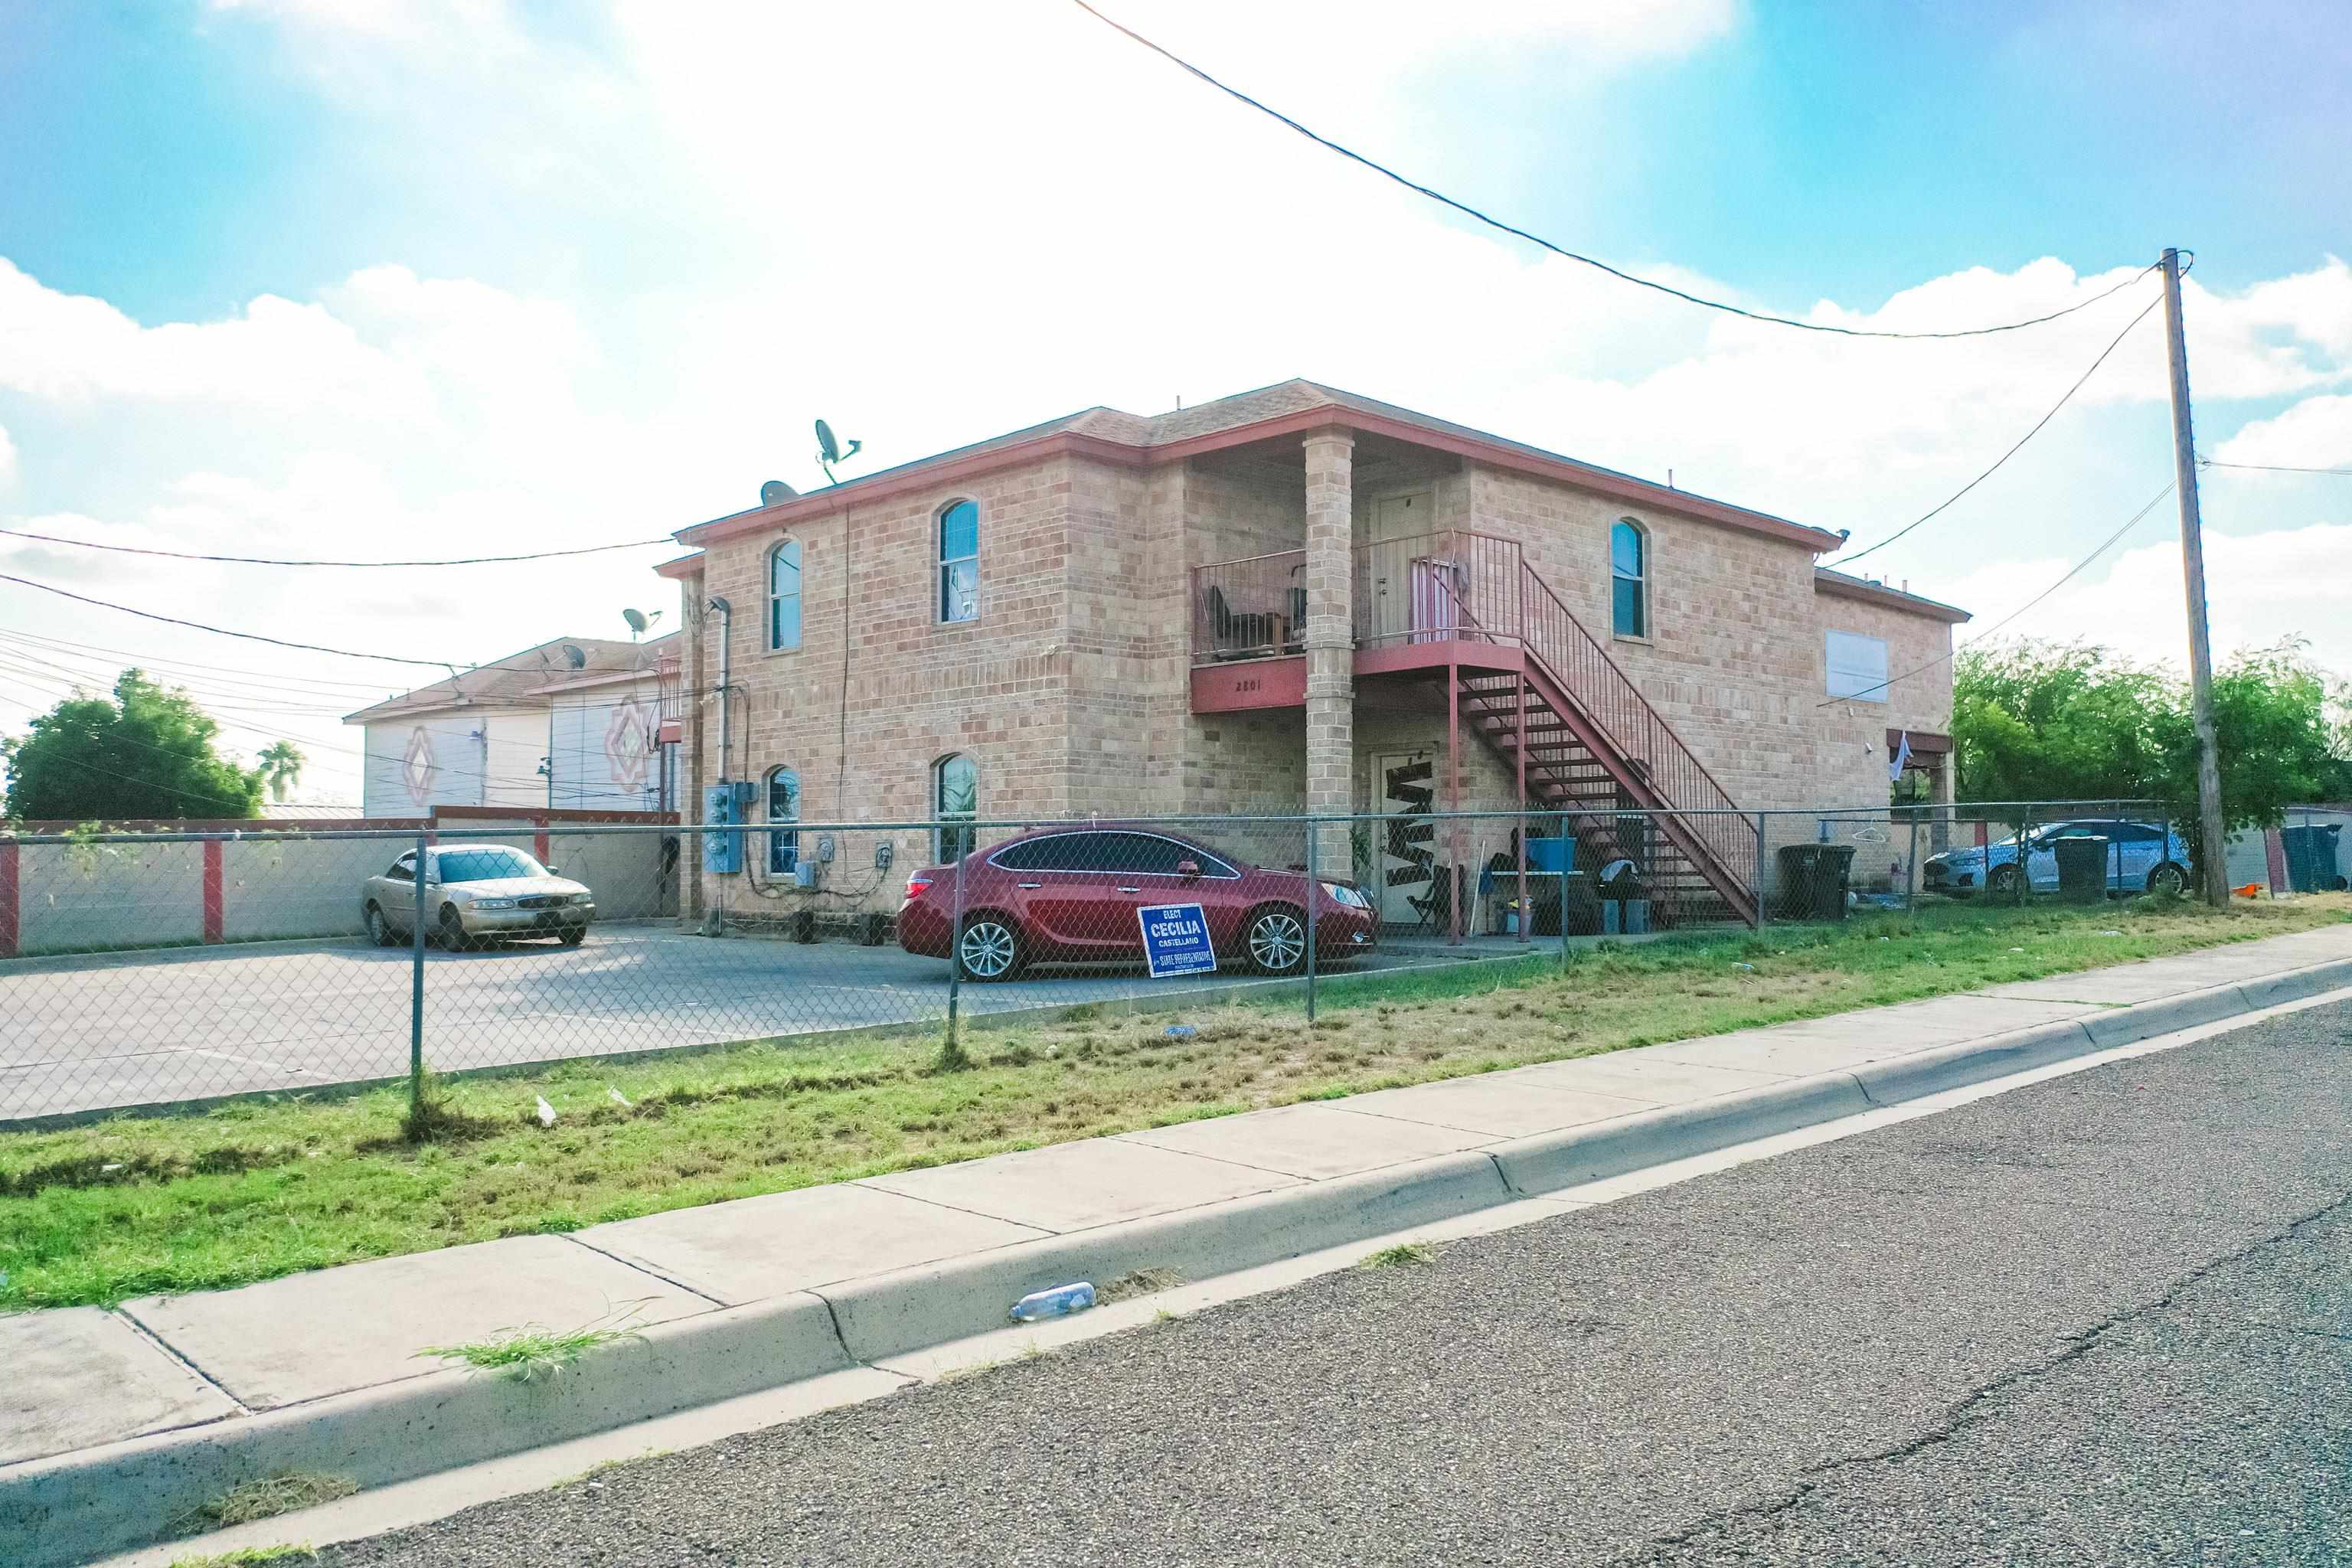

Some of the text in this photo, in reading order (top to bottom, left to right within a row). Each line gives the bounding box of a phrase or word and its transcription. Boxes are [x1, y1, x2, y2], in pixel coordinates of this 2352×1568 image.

[1236, 680, 1261, 691] 2801
[1163, 910, 1181, 919] ELECT
[1151, 920, 1200, 937] CECILIA
[1158, 937, 1199, 947] CASTELLANO
[1159, 954, 1176, 966] STATE
[1174, 951, 1212, 965] REPRESENTATIVE
